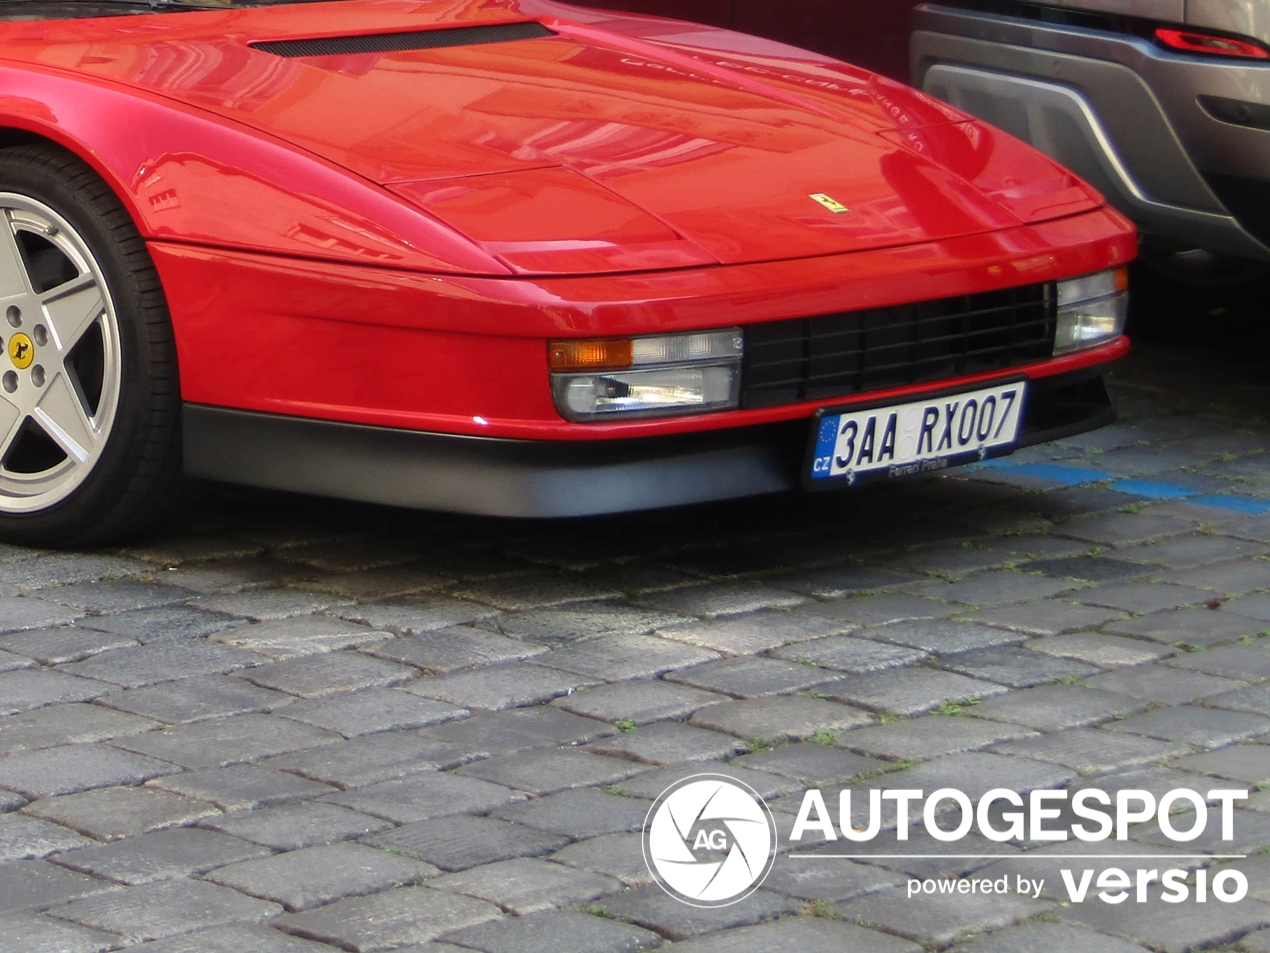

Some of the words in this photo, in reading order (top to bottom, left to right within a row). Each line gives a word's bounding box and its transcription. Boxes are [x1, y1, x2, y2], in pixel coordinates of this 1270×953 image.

[836, 412, 898, 469] 3AA
[916, 389, 1017, 456] RX007
[813, 456, 829, 472] CZ
[888, 460, 920, 478] Ferrari
[921, 457, 948, 473] Praha
